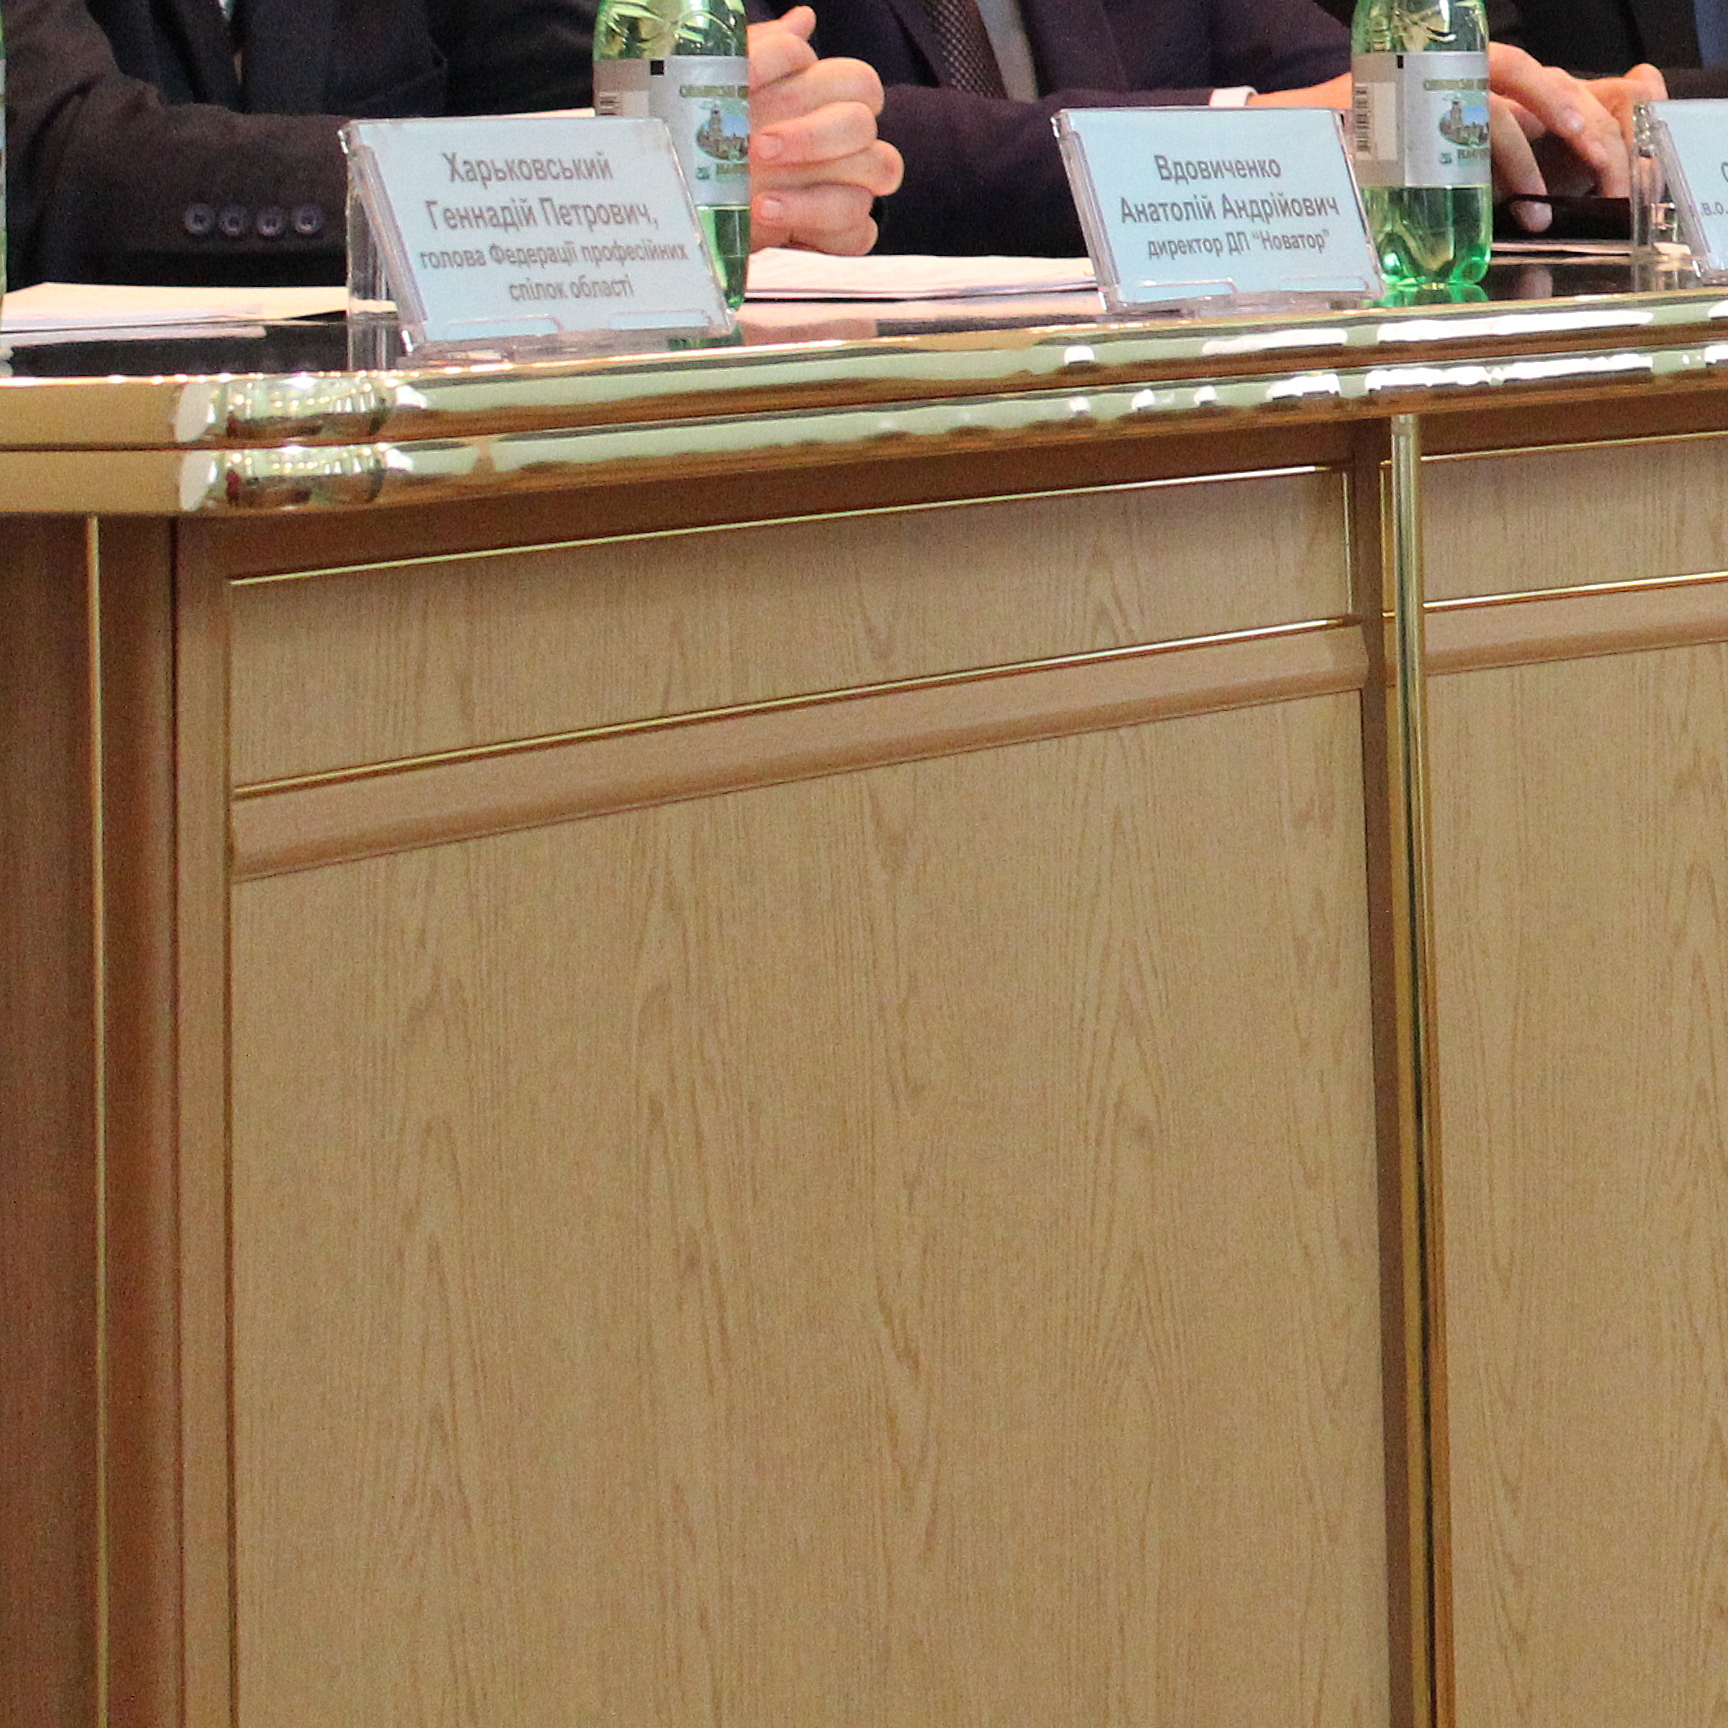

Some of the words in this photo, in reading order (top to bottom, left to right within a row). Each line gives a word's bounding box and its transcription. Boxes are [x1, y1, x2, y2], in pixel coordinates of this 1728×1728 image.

[1154, 154, 1282, 183] Вдовиченко
[426, 198, 537, 233] Геннадій
[541, 196, 659, 232] Петрович,
[1120, 196, 1217, 224] Анатолій
[1222, 194, 1339, 223] Андрійович
[420, 248, 487, 270] голова
[489, 245, 577, 270] Федерації
[581, 239, 689, 268] професійних
[1148, 235, 1223, 259] директор
[1227, 232, 1249, 256] ДП
[509, 275, 568, 302] спілок
[570, 273, 635, 300] області
